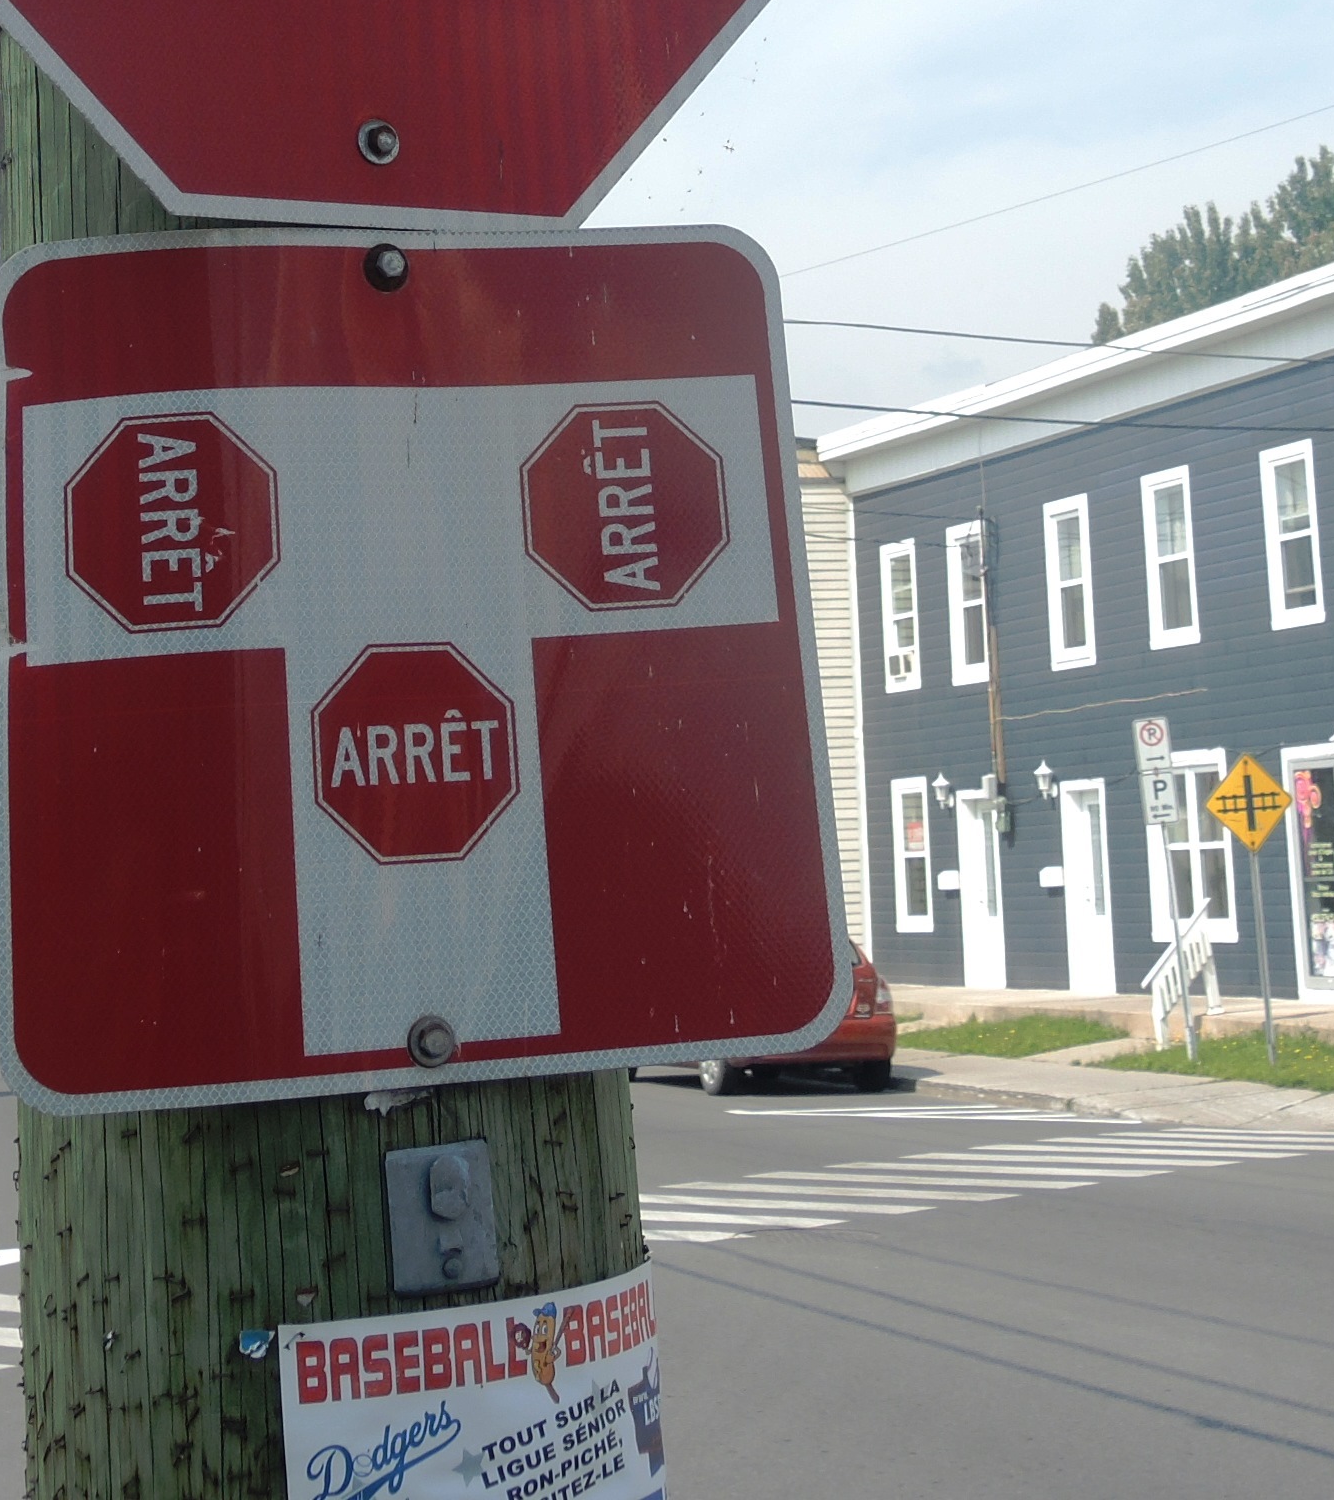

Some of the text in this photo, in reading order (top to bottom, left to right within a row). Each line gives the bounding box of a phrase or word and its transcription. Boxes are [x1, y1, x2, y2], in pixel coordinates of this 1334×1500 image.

[137, 432, 216, 612] ARRÊT
[582, 419, 661, 592] ARRÊT
[330, 709, 499, 788] ARRÊT
[1153, 780, 1167, 800] P
[296, 1316, 528, 1405] BASEBALL
[481, 1398, 627, 1490] LIGUE SÉNIOR
[482, 1379, 620, 1462] TOUT SUR LA
